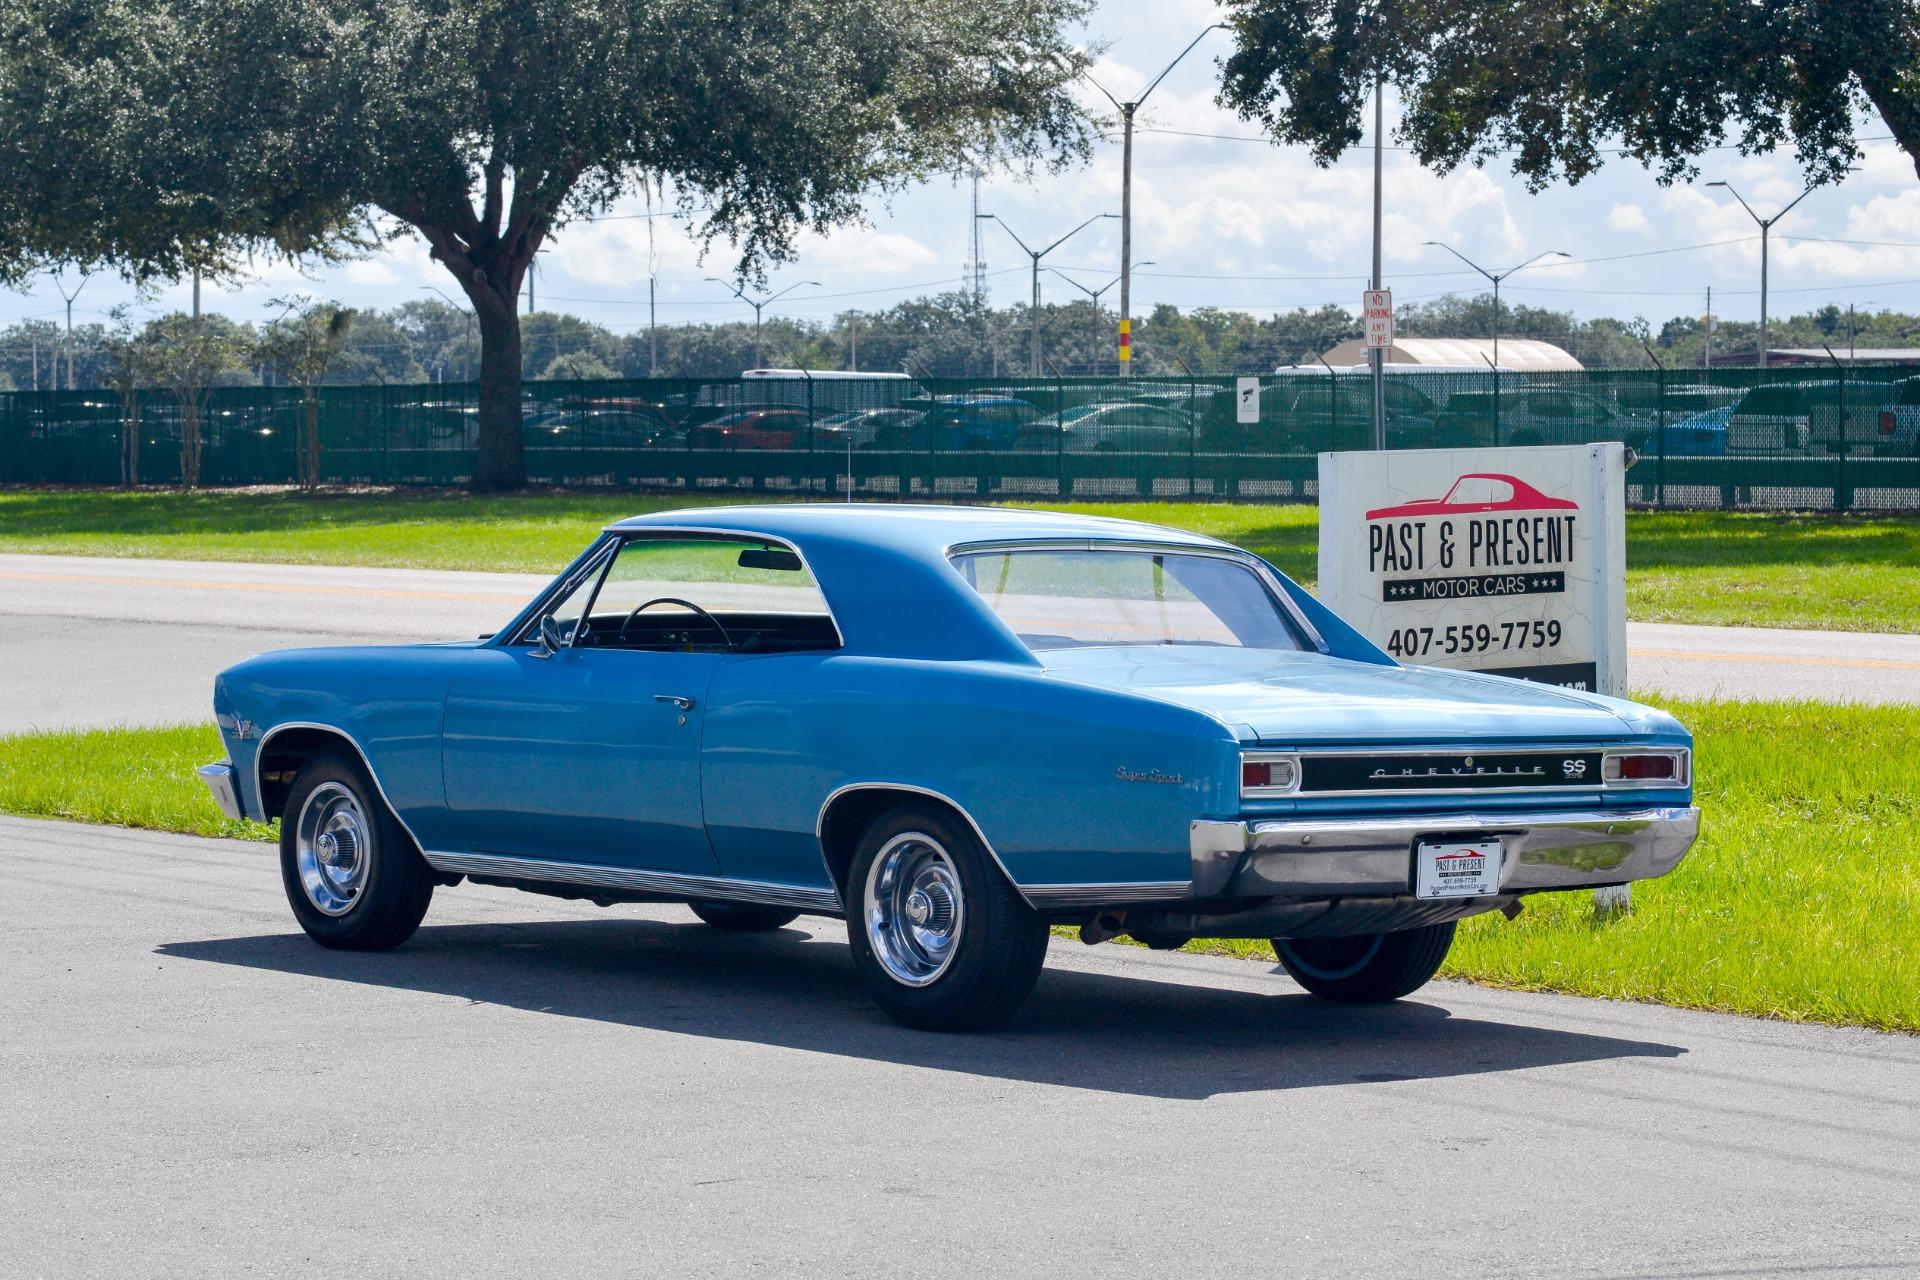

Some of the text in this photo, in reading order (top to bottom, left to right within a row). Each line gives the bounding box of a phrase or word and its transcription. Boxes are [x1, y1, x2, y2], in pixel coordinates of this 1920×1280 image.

[1372, 295, 1383, 306] NO
[1366, 308, 1391, 319] PARKING
[1372, 324, 1384, 332] ANY
[1371, 334, 1387, 344] TIME
[1369, 515, 1576, 573] PAST & PRESENT
[1423, 576, 1526, 598] MOTOR CARS
[1387, 619, 1562, 657] 407-559-7759
[1374, 766, 1543, 777] CHEVELLE
[1562, 759, 1586, 773] SS
[1435, 858, 1486, 871] PAST & PRESENT
